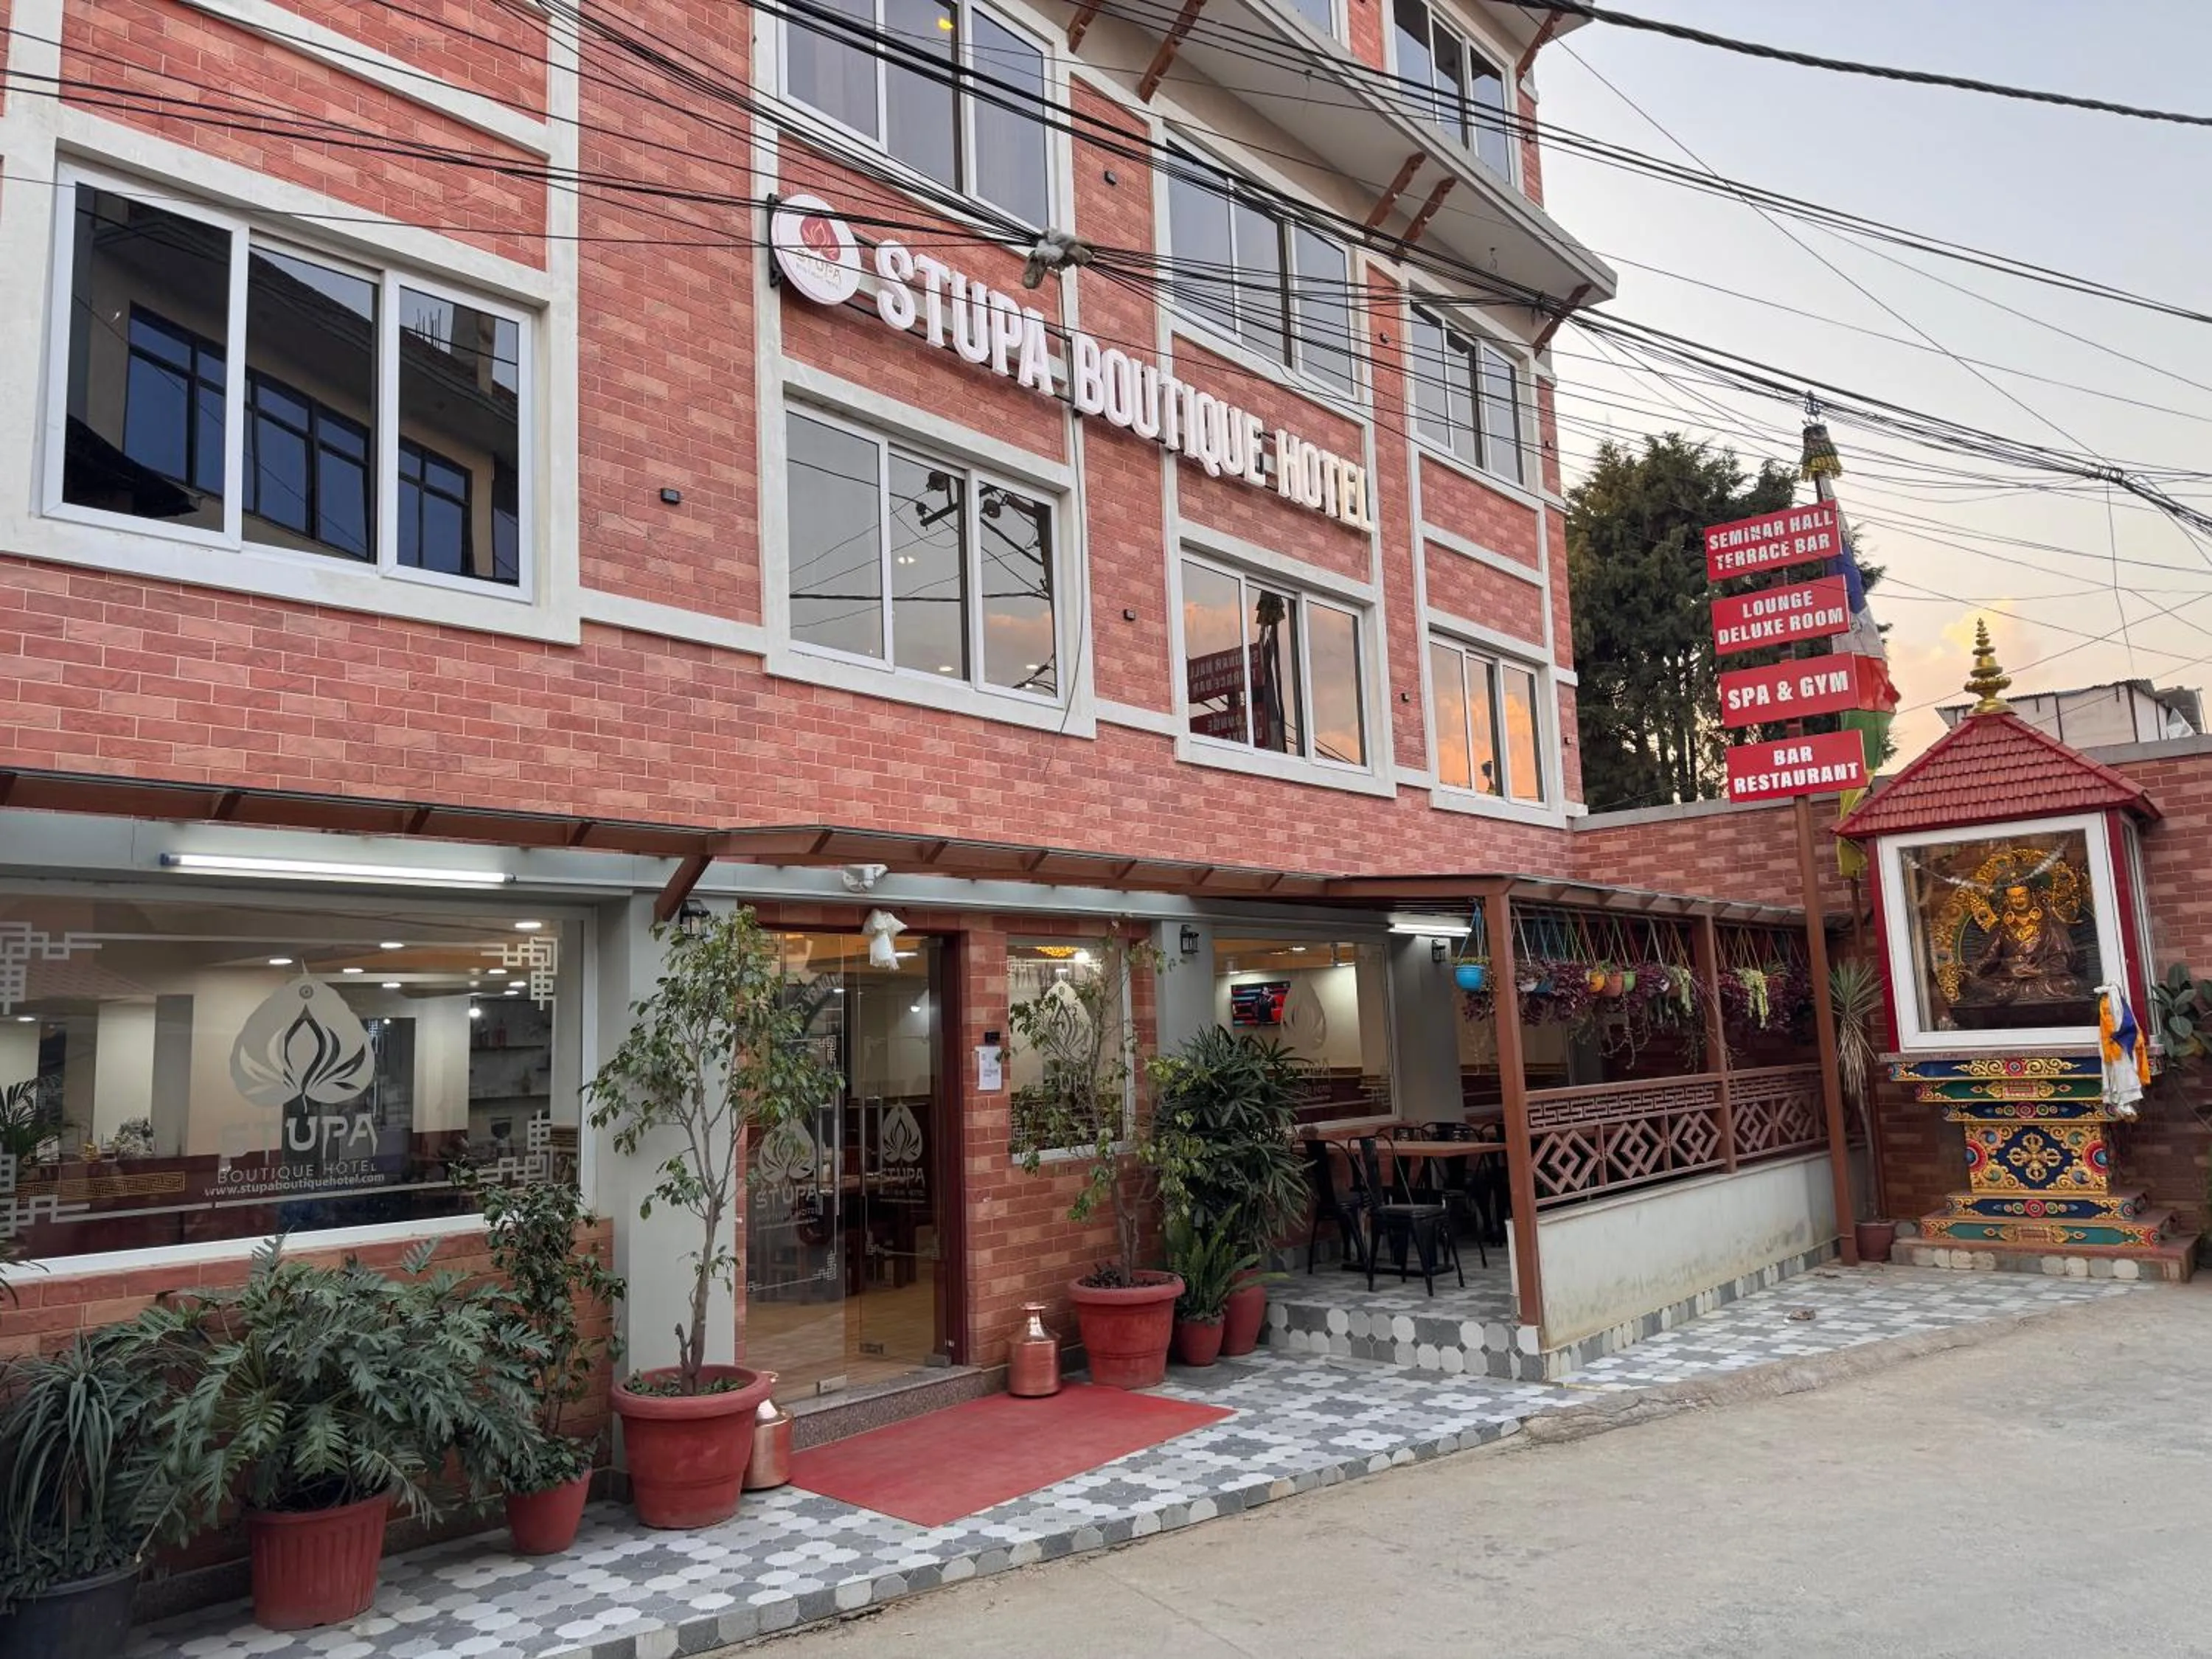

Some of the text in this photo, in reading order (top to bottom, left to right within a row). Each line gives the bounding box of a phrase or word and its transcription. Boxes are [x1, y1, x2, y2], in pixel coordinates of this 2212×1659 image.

[874, 239, 1374, 532] STUPA BOUTIQUE HOTEL
[1708, 509, 1834, 550] SEMINAR HALL
[1715, 532, 1830, 570] TERRACE BAR
[1742, 590, 1813, 619] LOUNGE
[1717, 607, 1843, 645] DELUXE ROOM
[1728, 670, 1849, 710] SPA & GYM
[1773, 745, 1813, 766] BAR
[1733, 762, 1859, 794] RESTAURANT
[204, 1173, 384, 1197] www.stupaboutiquehotel.com
[218, 1159, 377, 1184] BOUTIQUE HOTEL
[755, 1183, 821, 1213] STUPA
